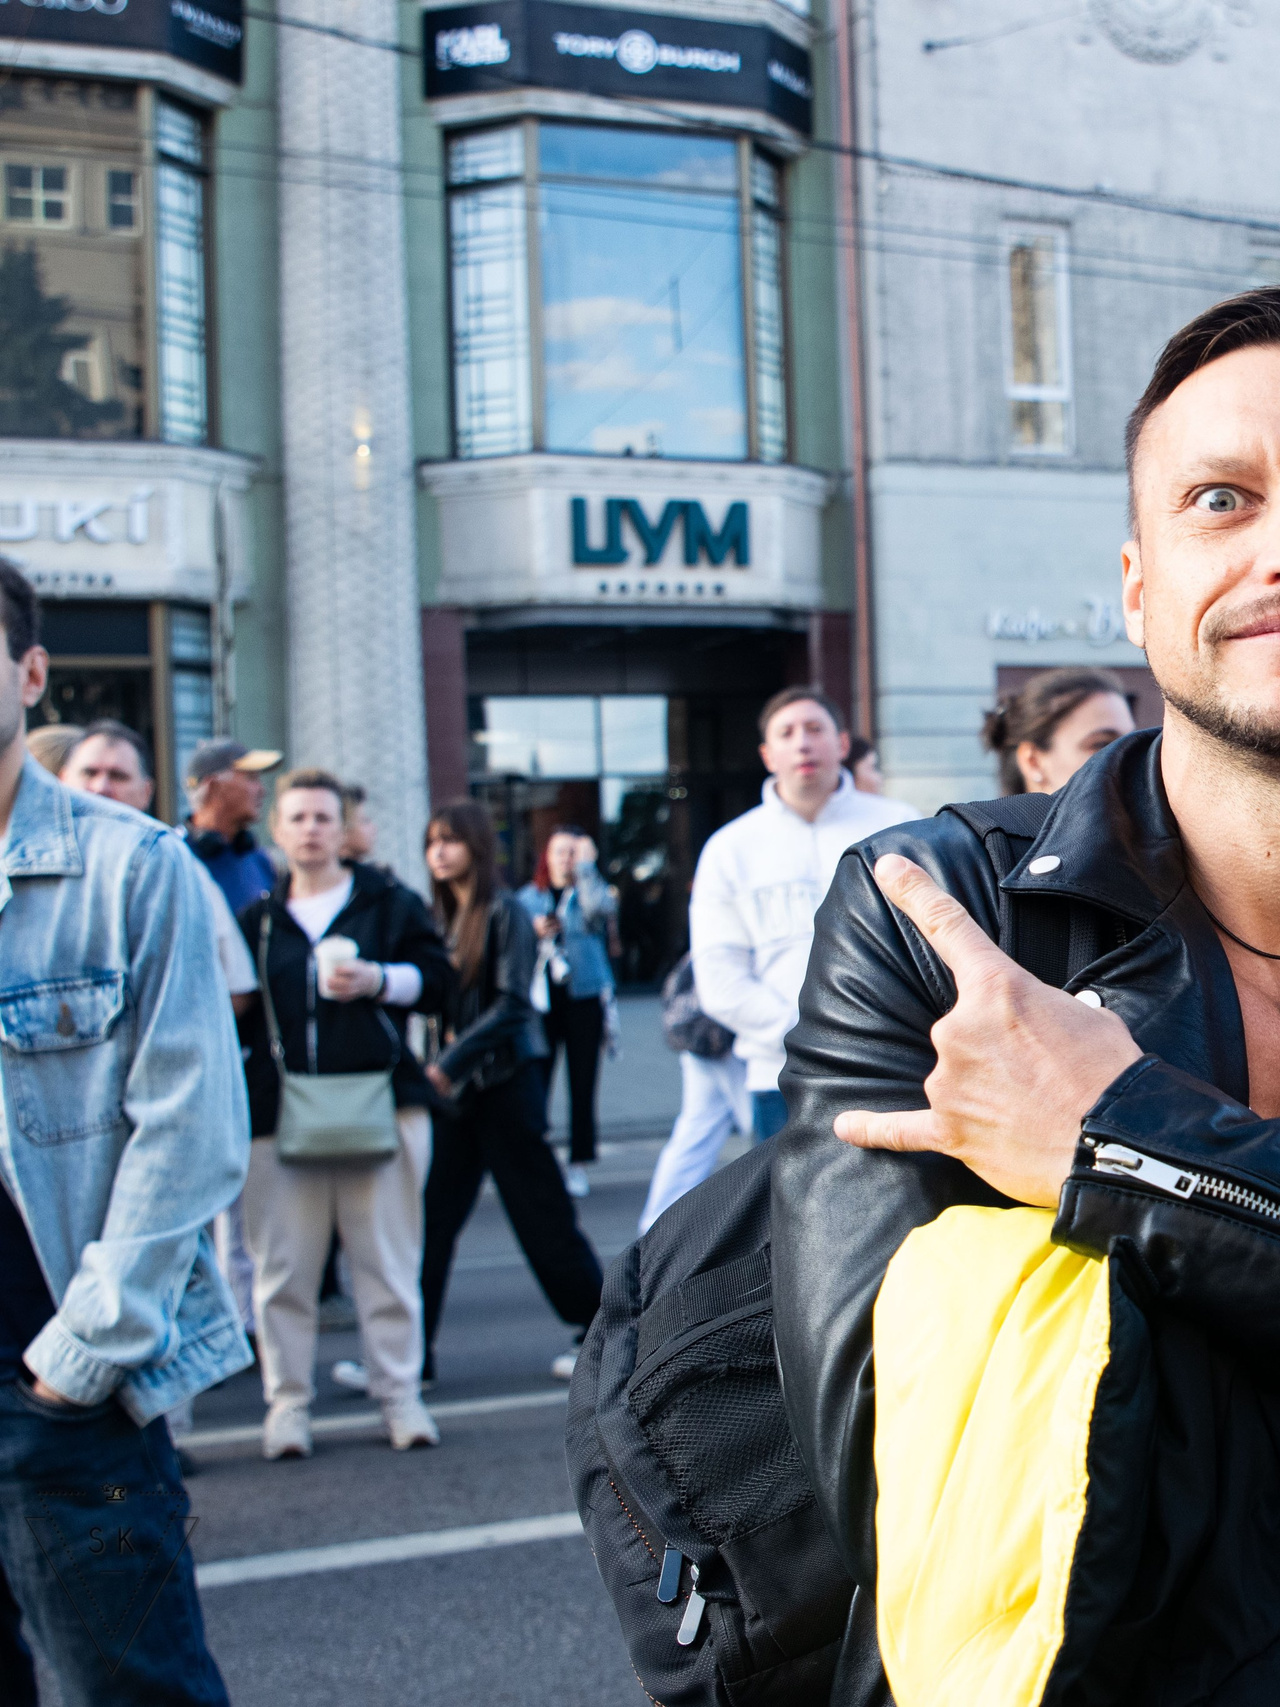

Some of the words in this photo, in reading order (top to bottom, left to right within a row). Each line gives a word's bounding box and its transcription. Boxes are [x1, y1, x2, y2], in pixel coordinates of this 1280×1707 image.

[553, 31, 616, 59] TORY
[656, 43, 742, 74] BURCH
[571, 496, 751, 567] ЦУМ
